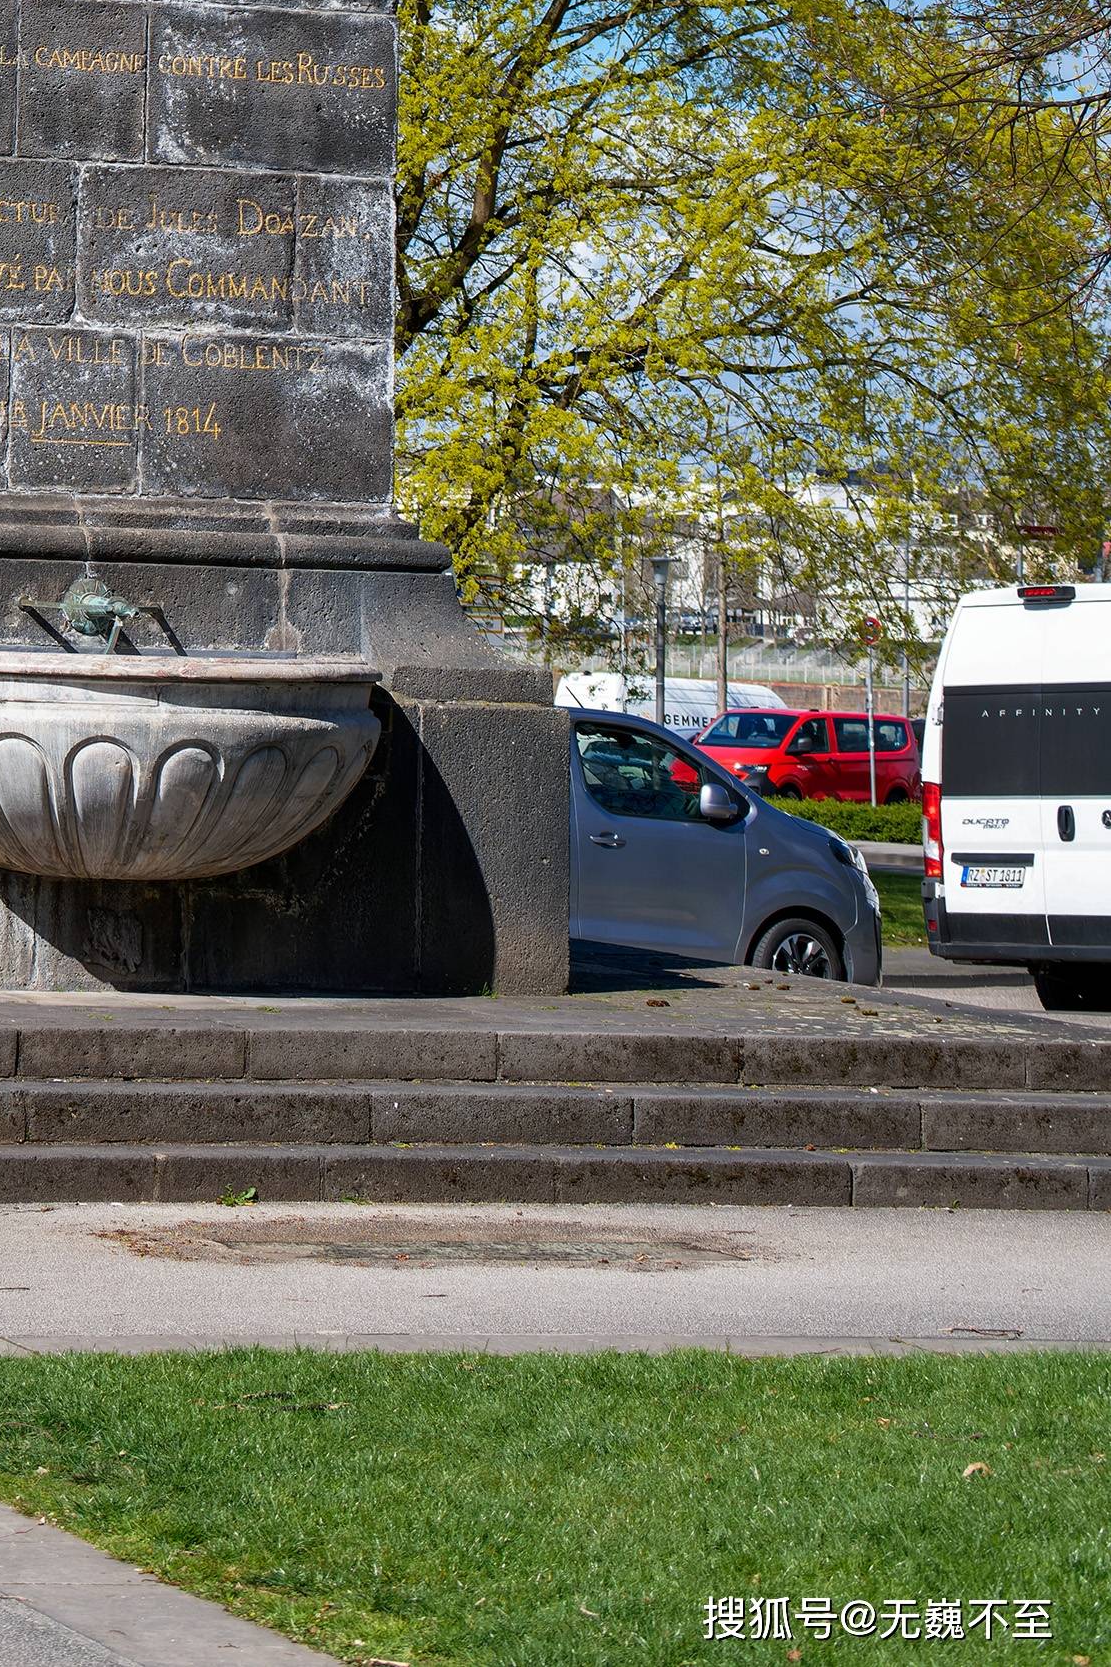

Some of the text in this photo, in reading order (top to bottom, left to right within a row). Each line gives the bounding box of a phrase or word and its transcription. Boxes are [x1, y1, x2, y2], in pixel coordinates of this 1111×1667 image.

[35, 47, 145, 72] CAMPAGNE
[158, 53, 247, 79] CONTRE
[256, 59, 294, 84] LES
[296, 51, 385, 89] RUSSES
[96, 207, 135, 230] DE
[34, 265, 72, 291] PA
[165, 257, 373, 305] COMMANDANT
[47, 336, 126, 365] VILLE
[180, 332, 326, 373] COBLENTZ
[31, 400, 153, 436] JANVIER
[163, 400, 221, 439] 1814
[981, 707, 1100, 718] AFFINITY
[986, 869, 998, 882] ST
[999, 869, 1022, 882] 1811
